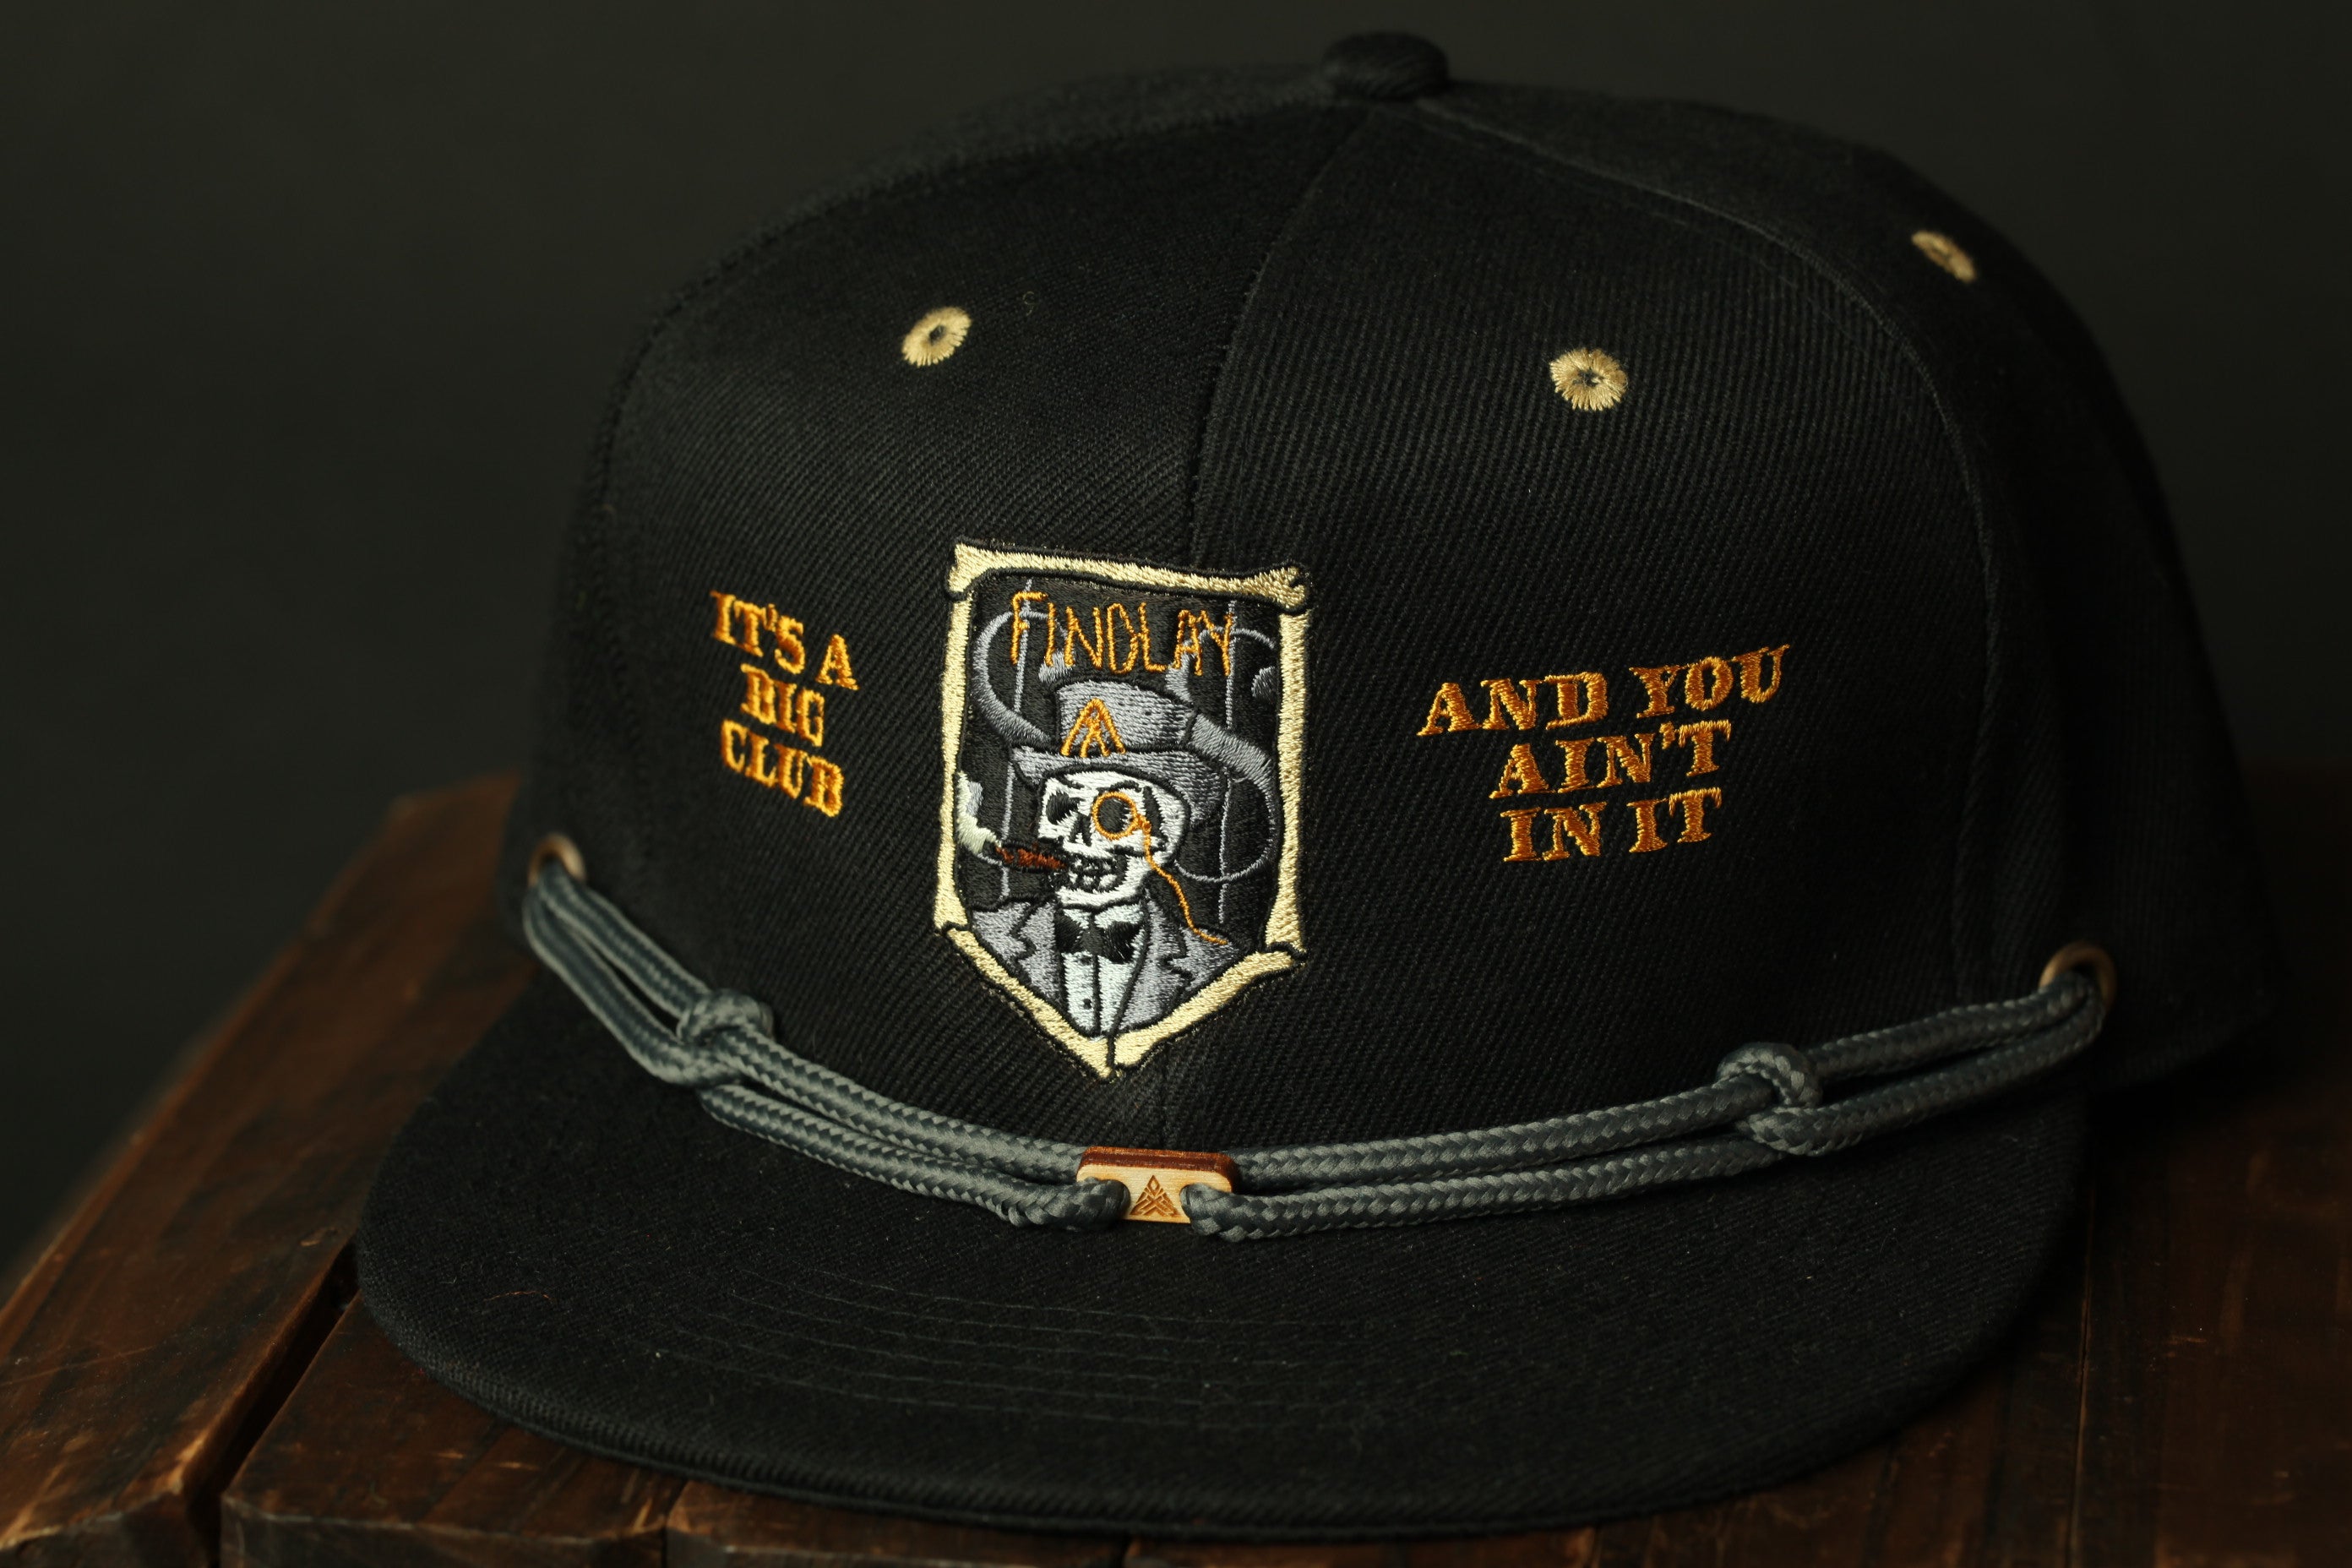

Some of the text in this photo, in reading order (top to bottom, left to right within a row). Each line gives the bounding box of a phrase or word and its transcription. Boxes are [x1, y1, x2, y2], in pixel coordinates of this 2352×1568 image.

[710, 591, 860, 691] IT'S A
[1010, 591, 1233, 677] FINDLAY
[740, 662, 825, 748] BIG
[1416, 644, 1790, 737] AND YOU
[721, 719, 845, 818] CLUB
[1489, 719, 1732, 799] AIN'T
[1500, 787, 1723, 863] IN IT
